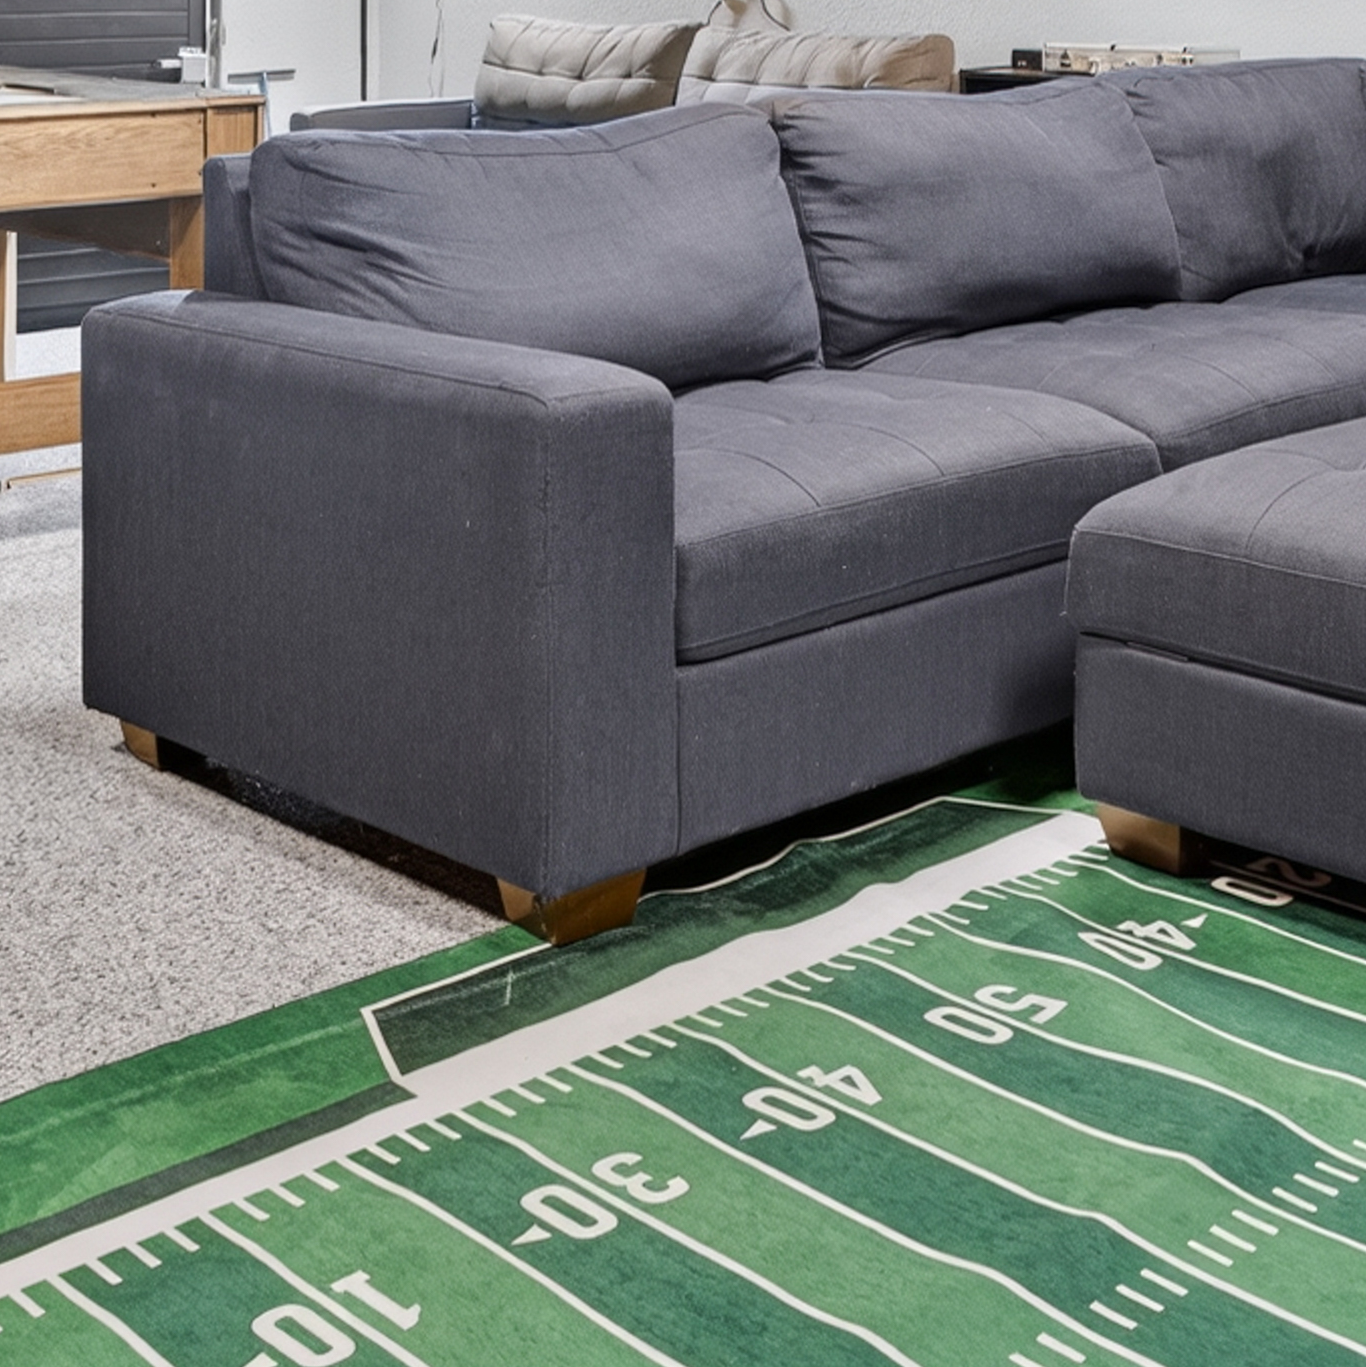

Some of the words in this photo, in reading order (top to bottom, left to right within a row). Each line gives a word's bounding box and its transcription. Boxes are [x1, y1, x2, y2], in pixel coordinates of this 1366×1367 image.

[923, 984, 1068, 1045] 50
[741, 1064, 884, 1132] 40
[519, 1151, 691, 1240] 30
[250, 1269, 422, 1367] 10
